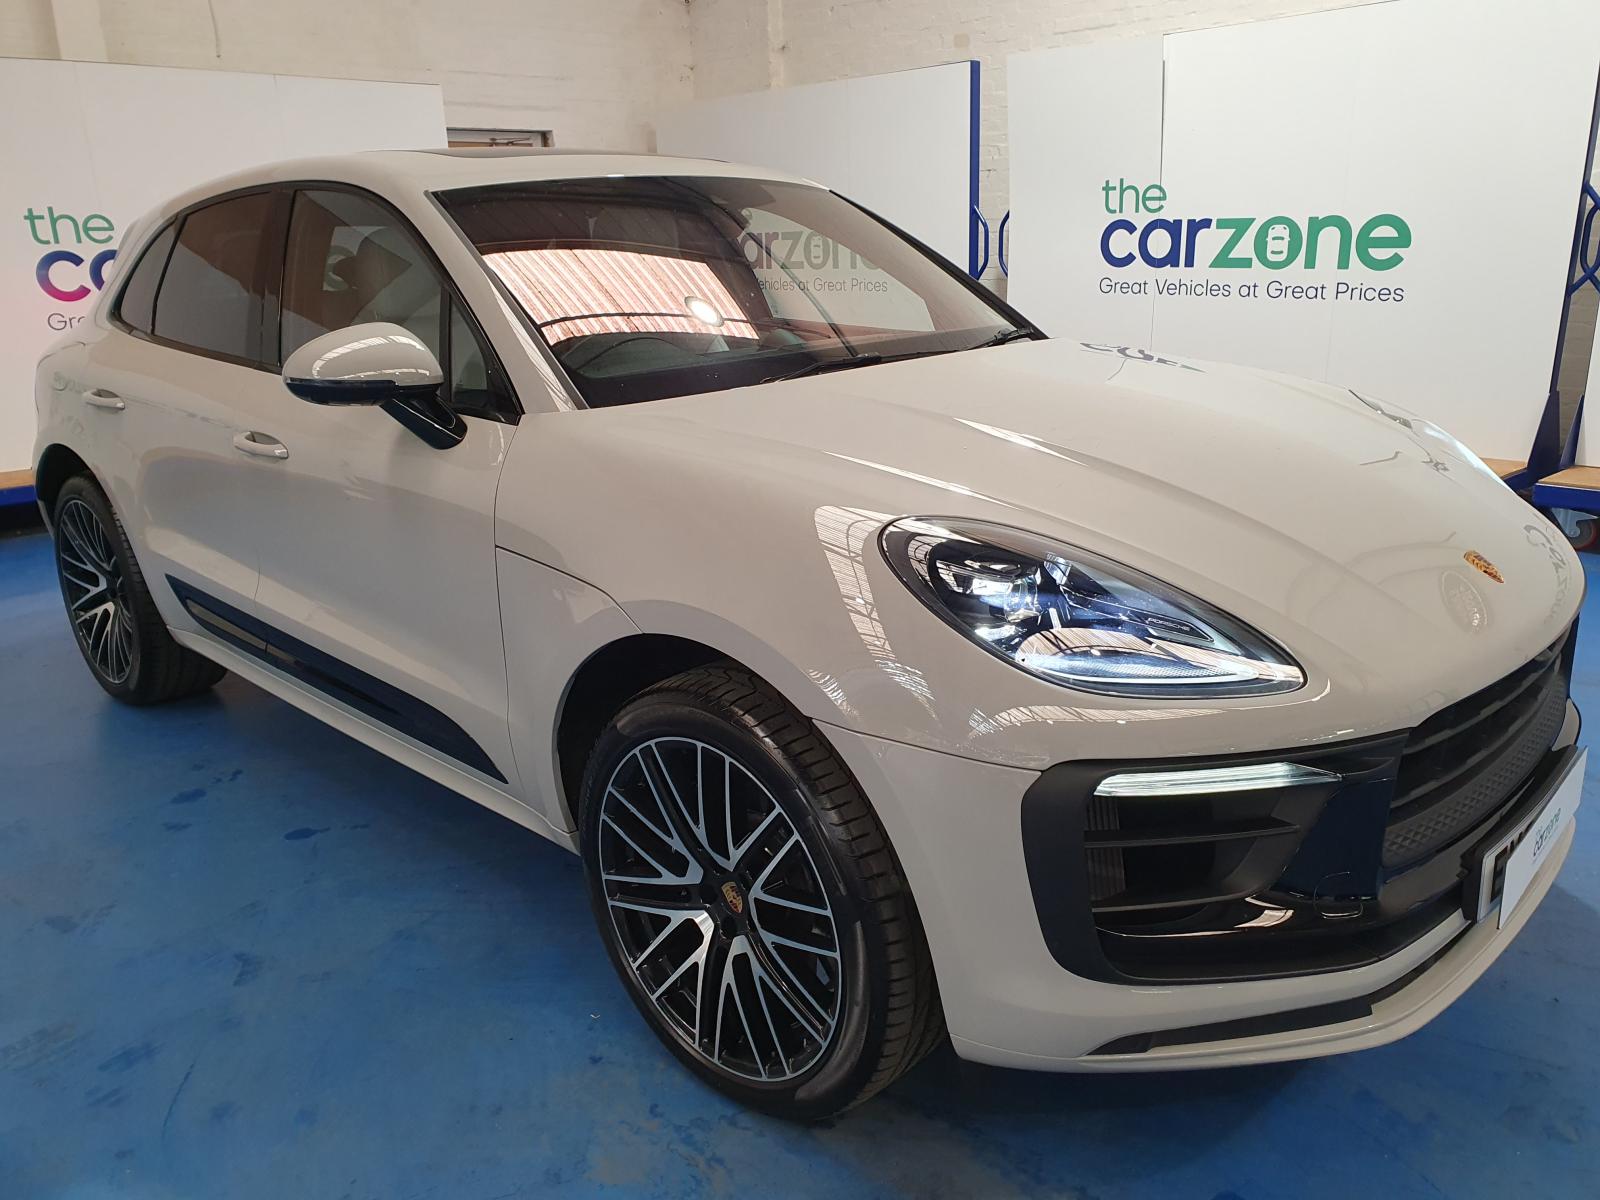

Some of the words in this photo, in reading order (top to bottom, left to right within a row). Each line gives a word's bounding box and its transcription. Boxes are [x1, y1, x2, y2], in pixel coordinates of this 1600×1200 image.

[1101, 178, 1167, 214] the
[23, 206, 115, 245] the
[1100, 213, 1412, 272] carzone
[813, 277, 847, 292] Great
[850, 277, 888, 292] Prices
[1099, 277, 1148, 295] Great
[1155, 279, 1231, 298] Vehicles
[1238, 284, 1259, 298] at
[1266, 280, 1327, 300] Great
[1335, 282, 1405, 302] Prices
